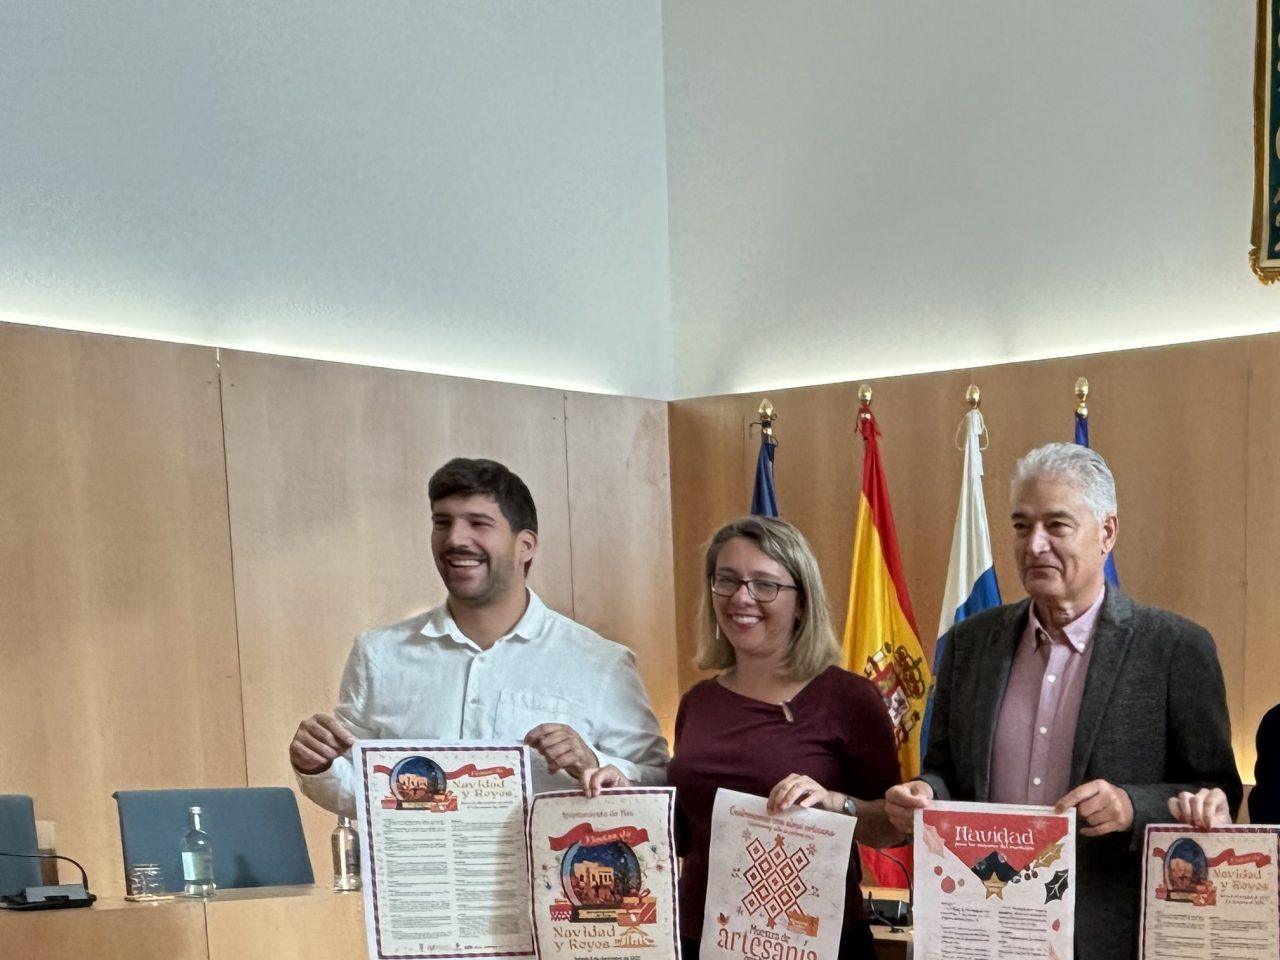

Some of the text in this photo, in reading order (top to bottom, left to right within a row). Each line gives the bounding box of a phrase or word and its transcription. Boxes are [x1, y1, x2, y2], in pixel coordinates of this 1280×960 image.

[954, 825, 1035, 846] Navidad
[553, 924, 616, 938] Navidad
[553, 940, 564, 952] y
